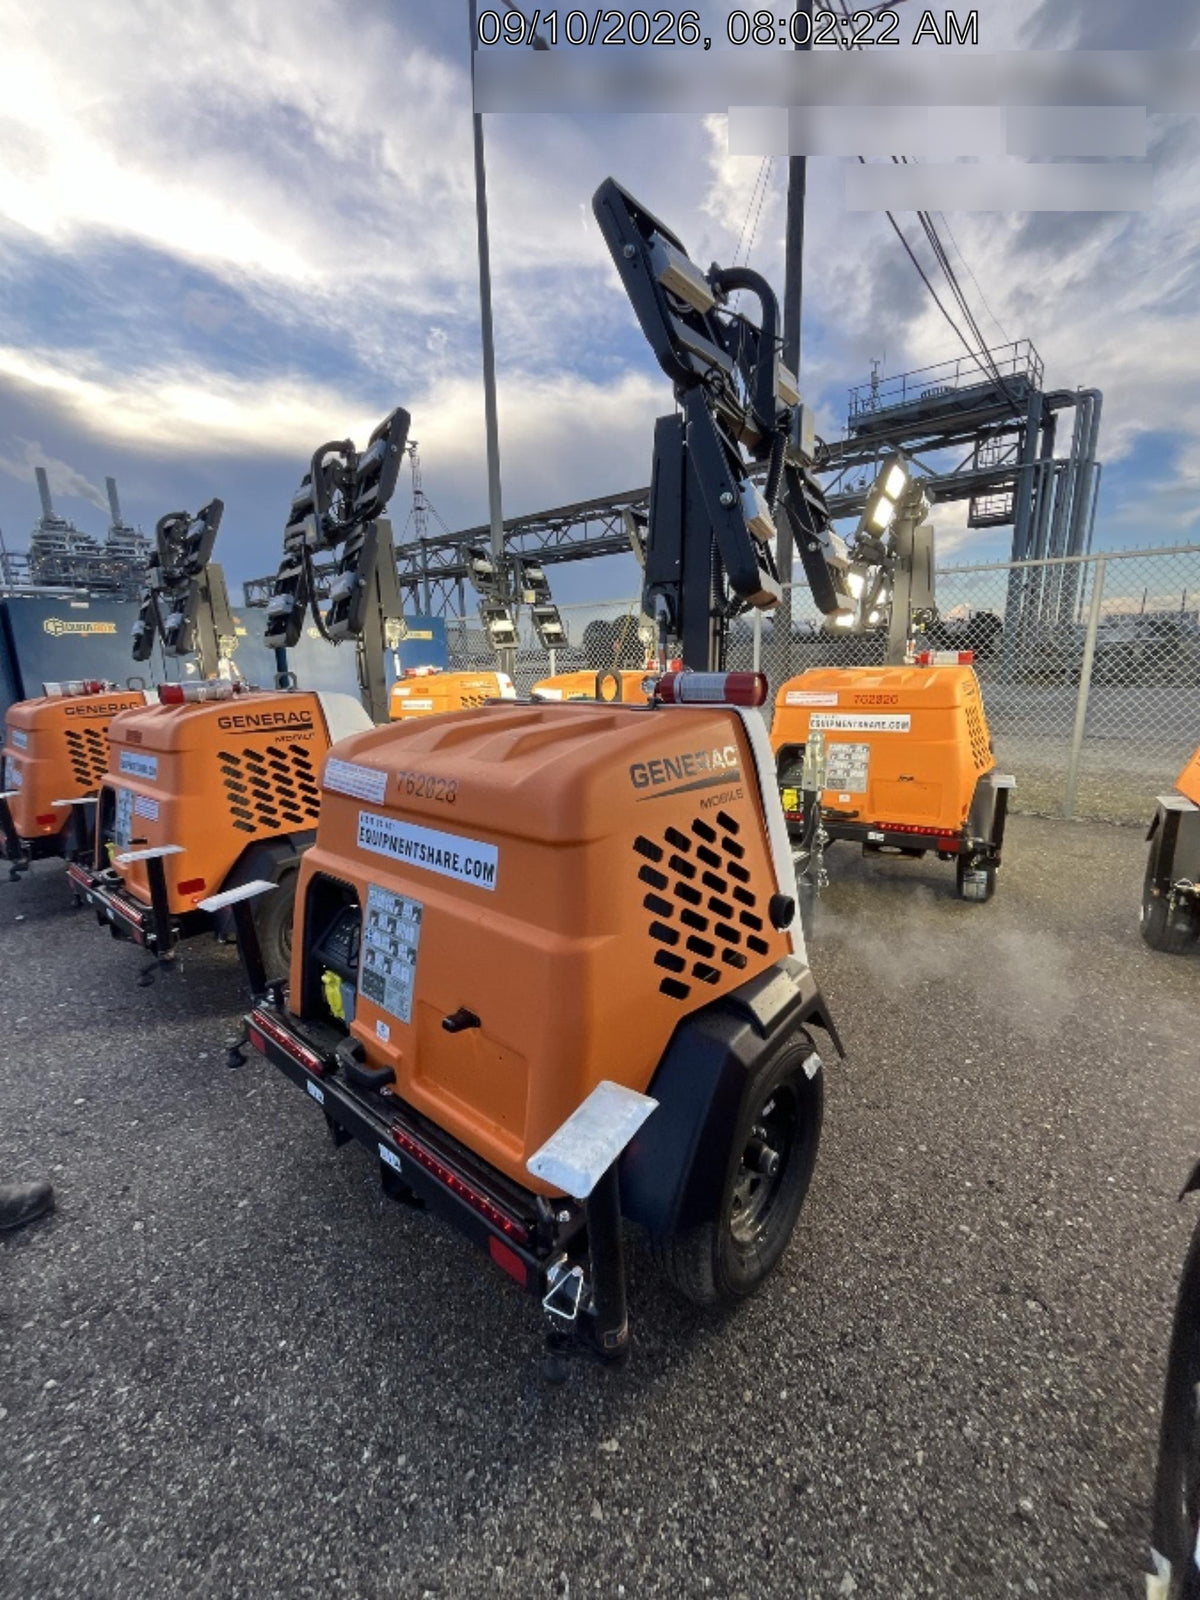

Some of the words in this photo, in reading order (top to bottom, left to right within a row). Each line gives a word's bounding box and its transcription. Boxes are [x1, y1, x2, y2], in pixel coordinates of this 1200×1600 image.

[217, 710, 312, 729] GENERAC
[629, 745, 738, 789] GENERAC
[700, 788, 744, 810] MOBILE
[359, 825, 495, 883] EQUIPMENTSHARE.COM
